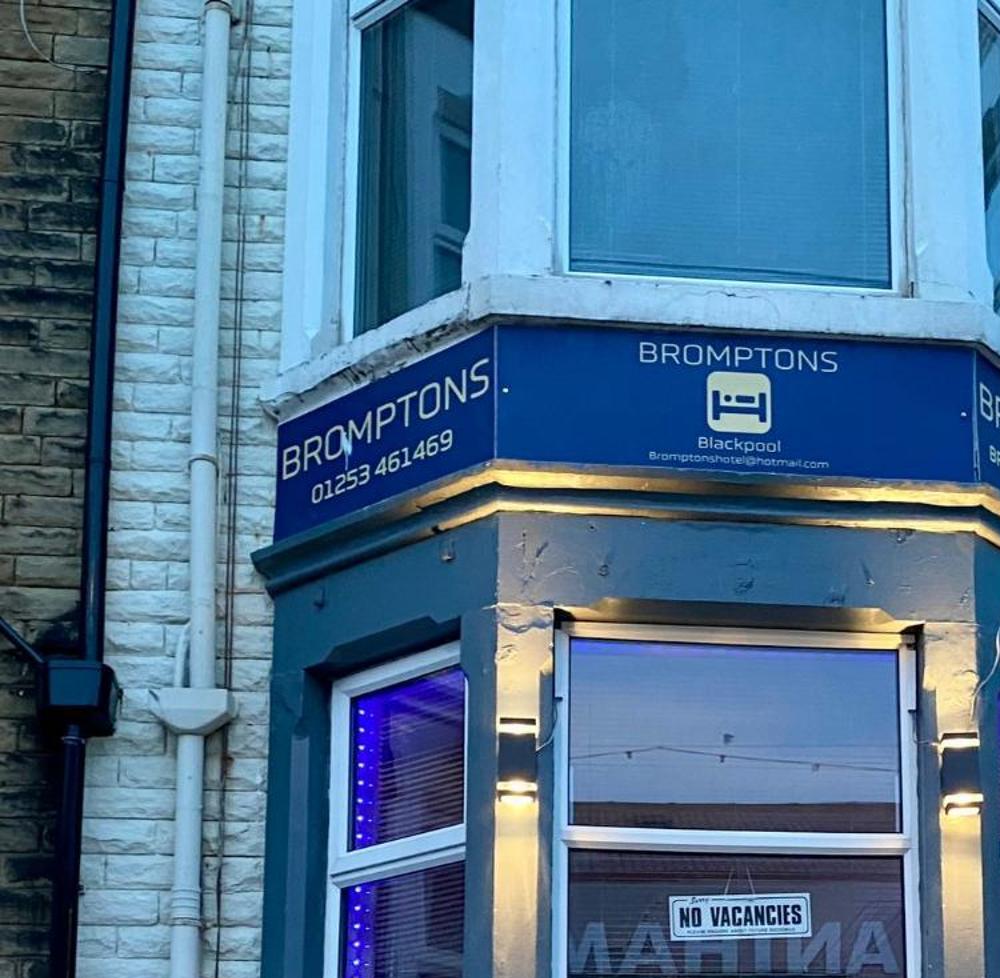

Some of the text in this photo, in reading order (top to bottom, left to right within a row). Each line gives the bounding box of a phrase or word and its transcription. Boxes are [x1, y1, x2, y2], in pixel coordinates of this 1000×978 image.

[639, 341, 838, 373] BROMPTONS
[282, 357, 490, 481] BROMPTONS
[697, 436, 782, 454] Blackpool
[311, 429, 453, 505] 01253 461469
[649, 451, 830, 469] Bromptonshotel@hotmail.com
[679, 904, 802, 928] NO VACANCIES
